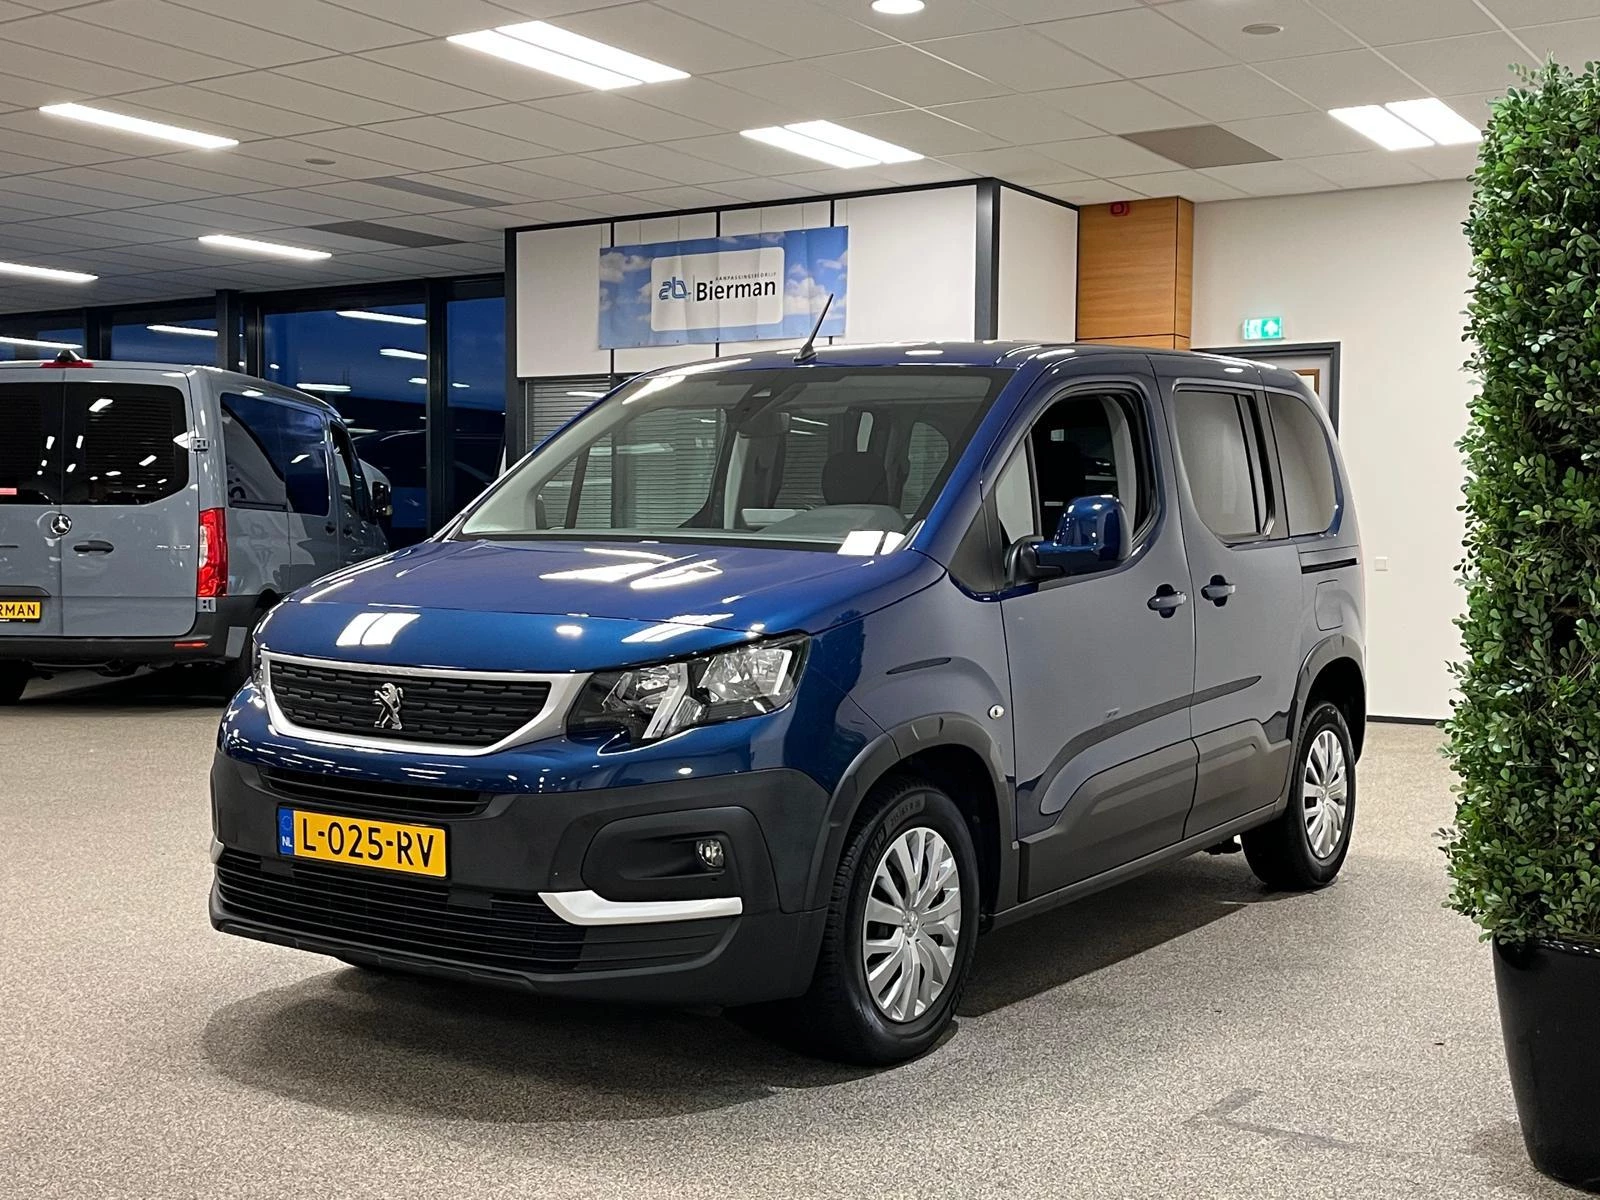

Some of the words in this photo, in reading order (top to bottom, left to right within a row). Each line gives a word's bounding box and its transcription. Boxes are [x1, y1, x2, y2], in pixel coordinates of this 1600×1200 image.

[696, 280, 776, 302] Bierman
[281, 836, 293, 848] NL
[302, 818, 434, 868] L-025-RV
